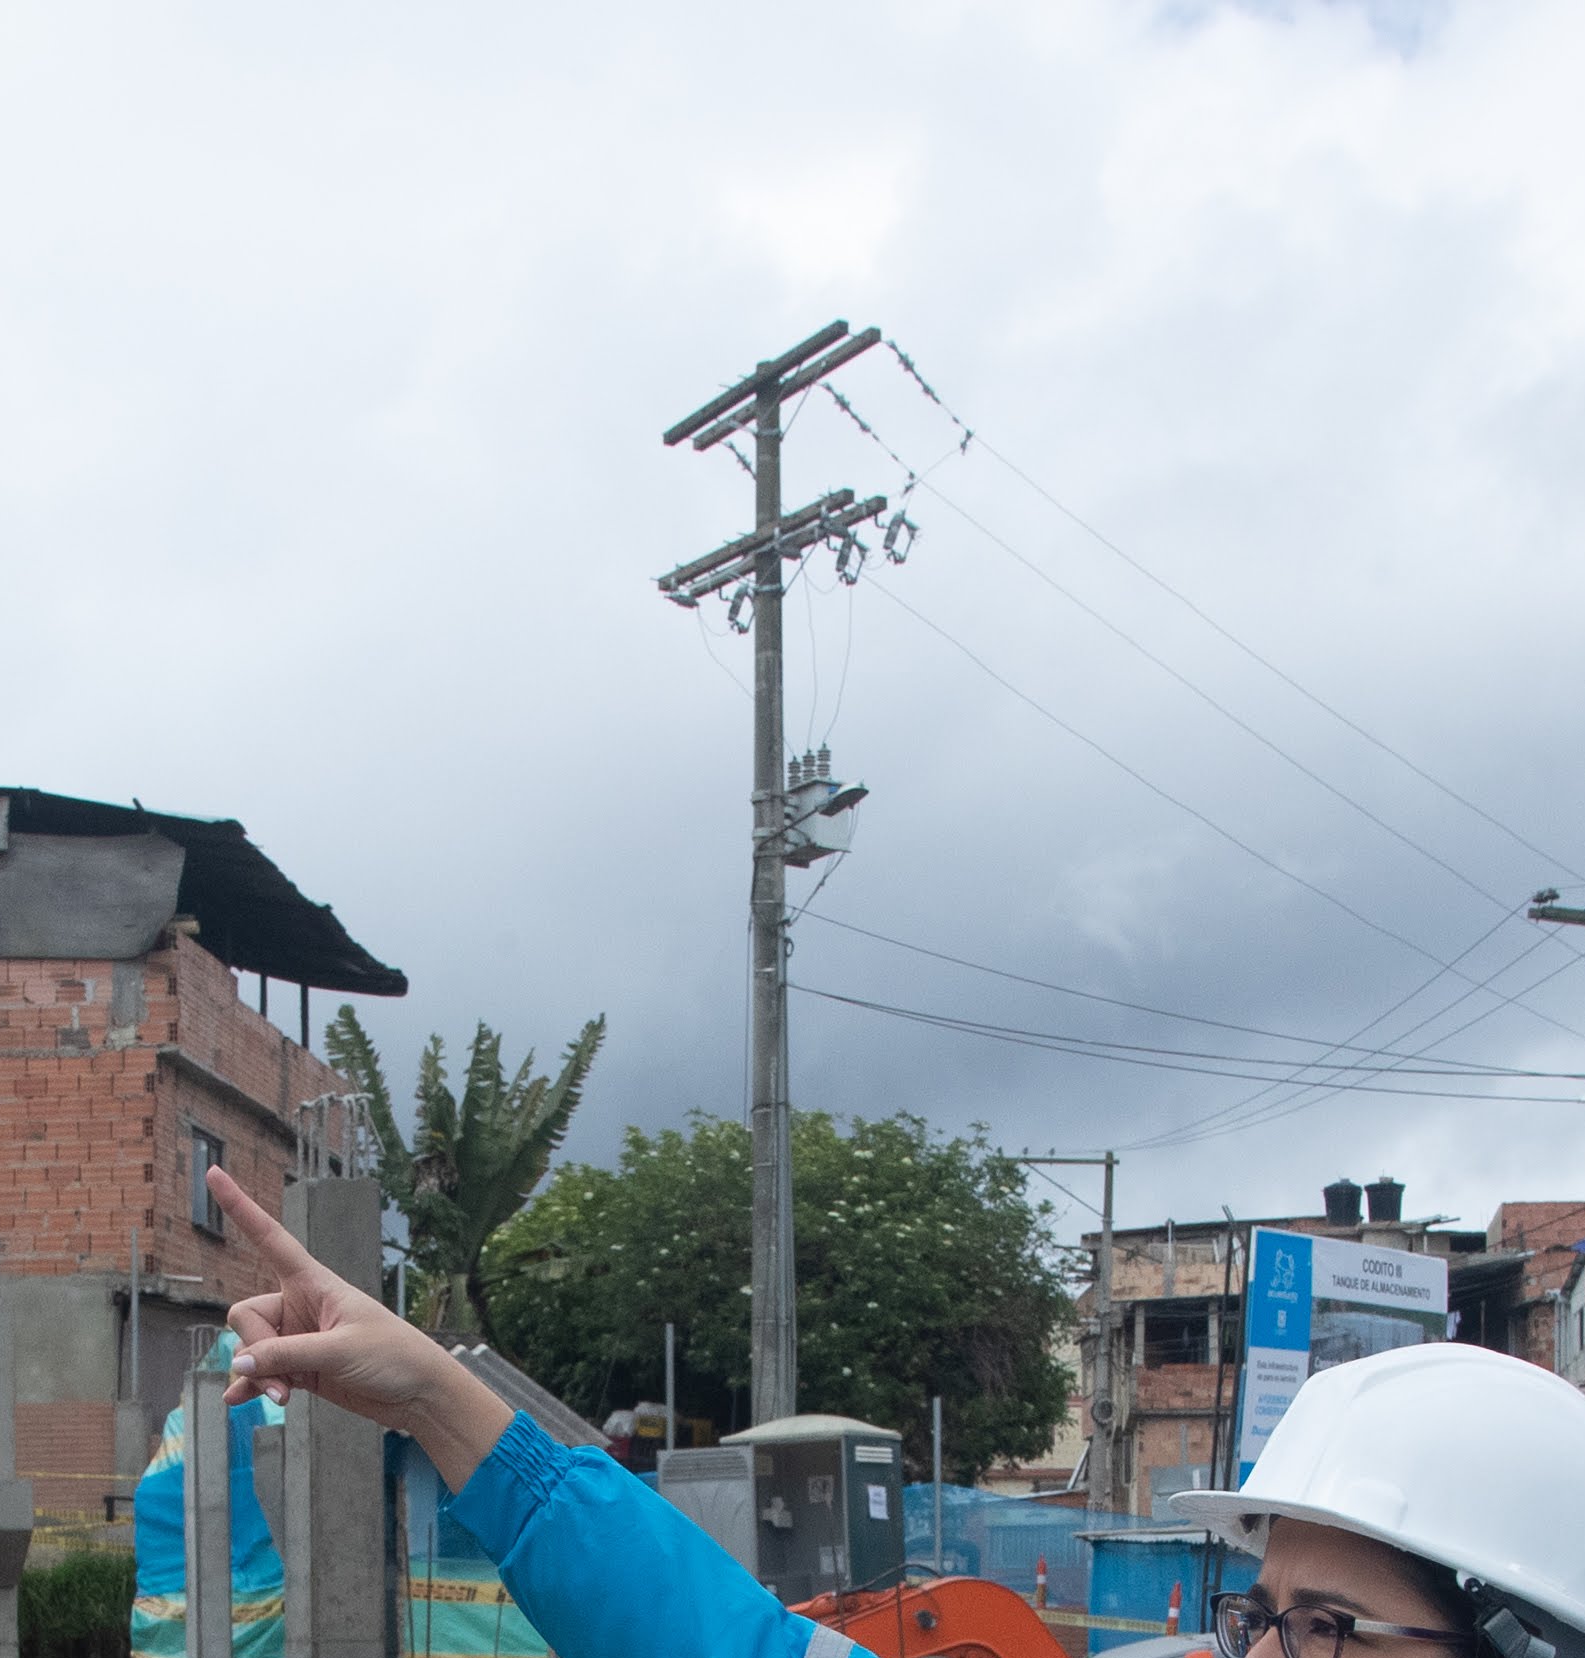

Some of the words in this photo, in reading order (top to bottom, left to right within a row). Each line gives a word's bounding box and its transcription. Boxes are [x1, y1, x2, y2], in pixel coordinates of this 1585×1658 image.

[1362, 1258, 1395, 1279] CODITO
[1331, 1274, 1360, 1291] TANQUE
[1359, 1279, 1371, 1292] DE
[1371, 1281, 1431, 1301] ALMACENAMIENTO
